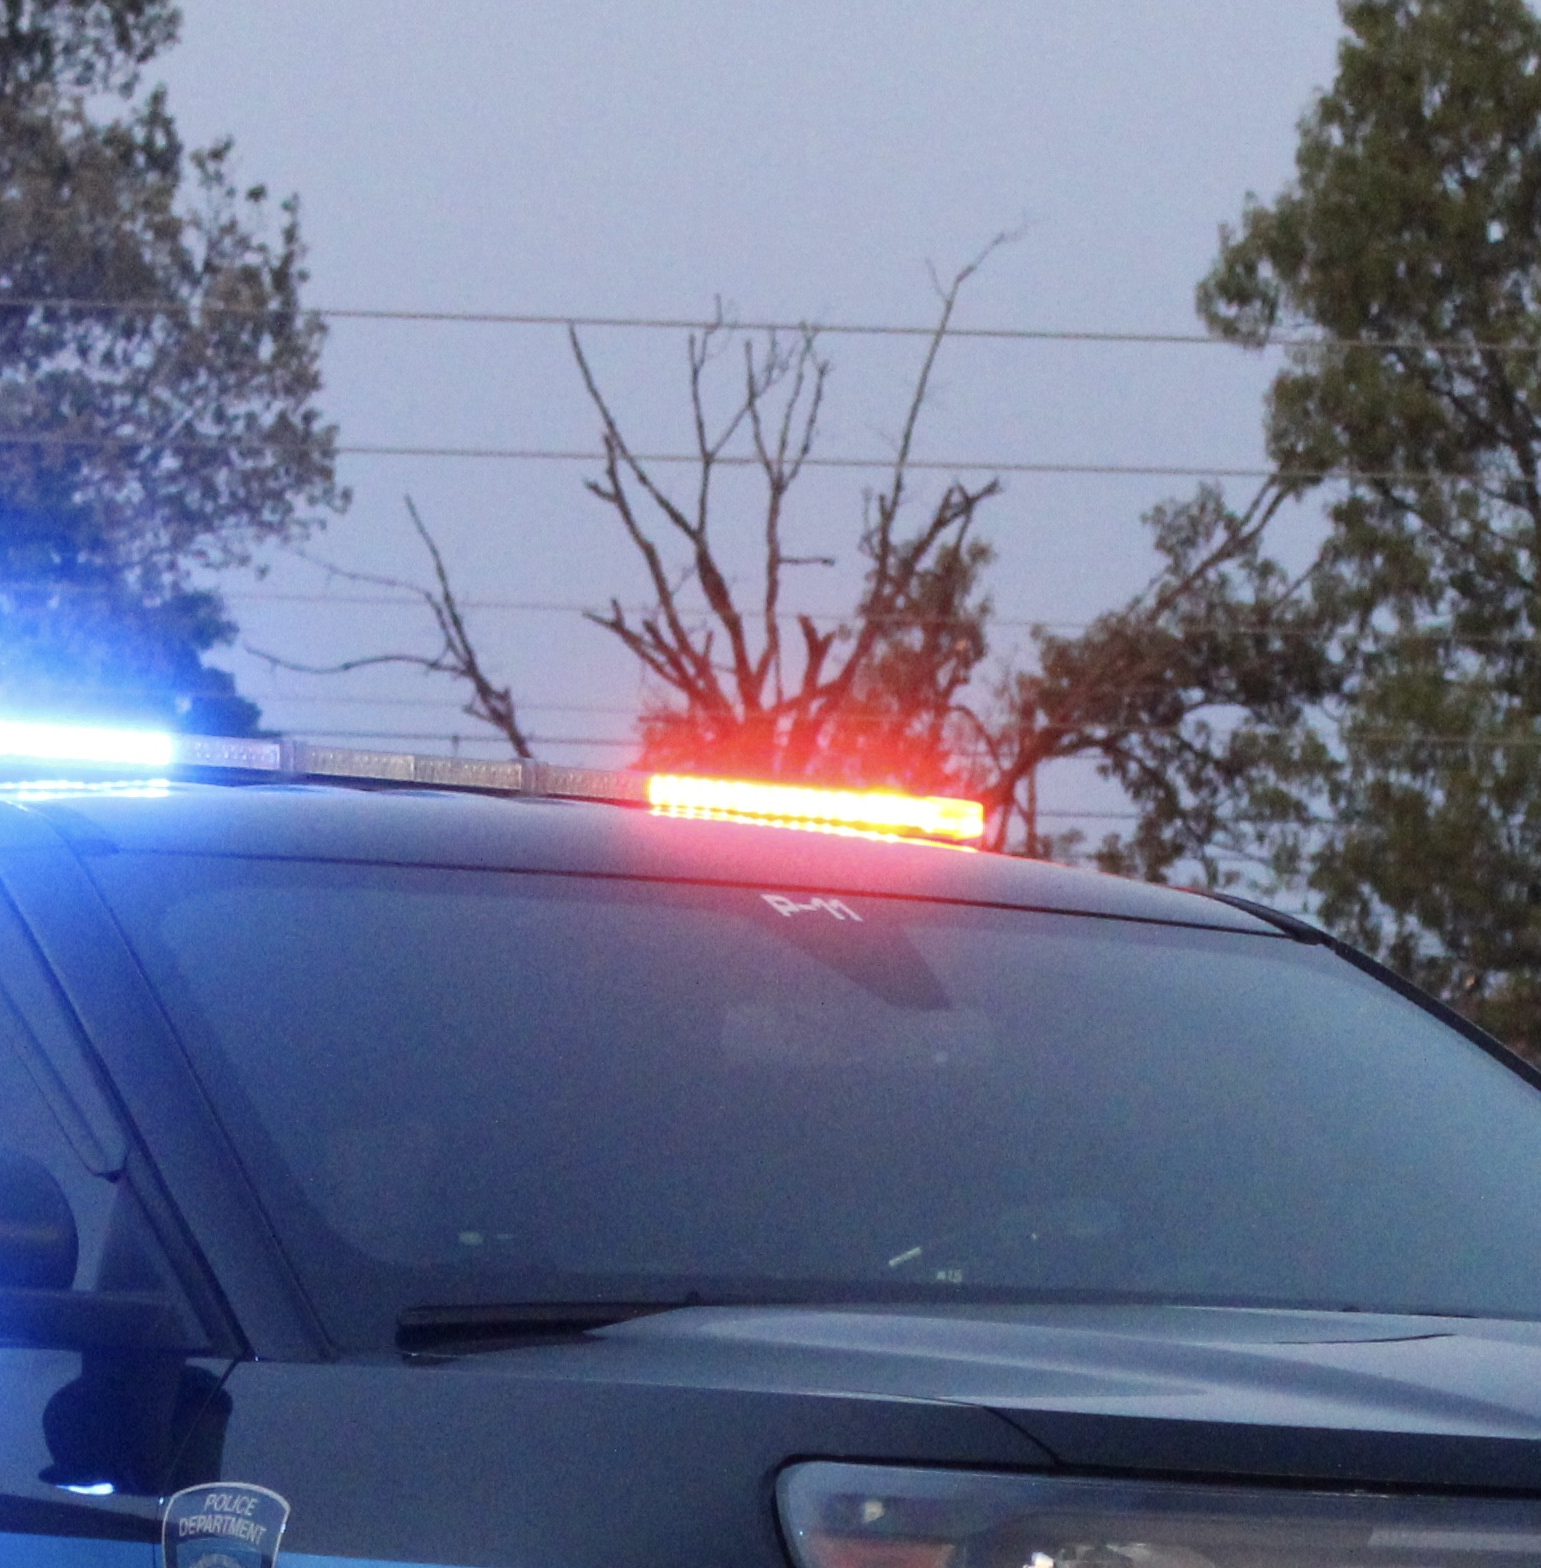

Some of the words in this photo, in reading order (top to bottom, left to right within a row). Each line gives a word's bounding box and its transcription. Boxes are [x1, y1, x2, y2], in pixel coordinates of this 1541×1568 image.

[760, 893, 863, 921] P-11
[204, 1493, 258, 1516] POLICE
[178, 1514, 267, 1546] DEPARTMENT
